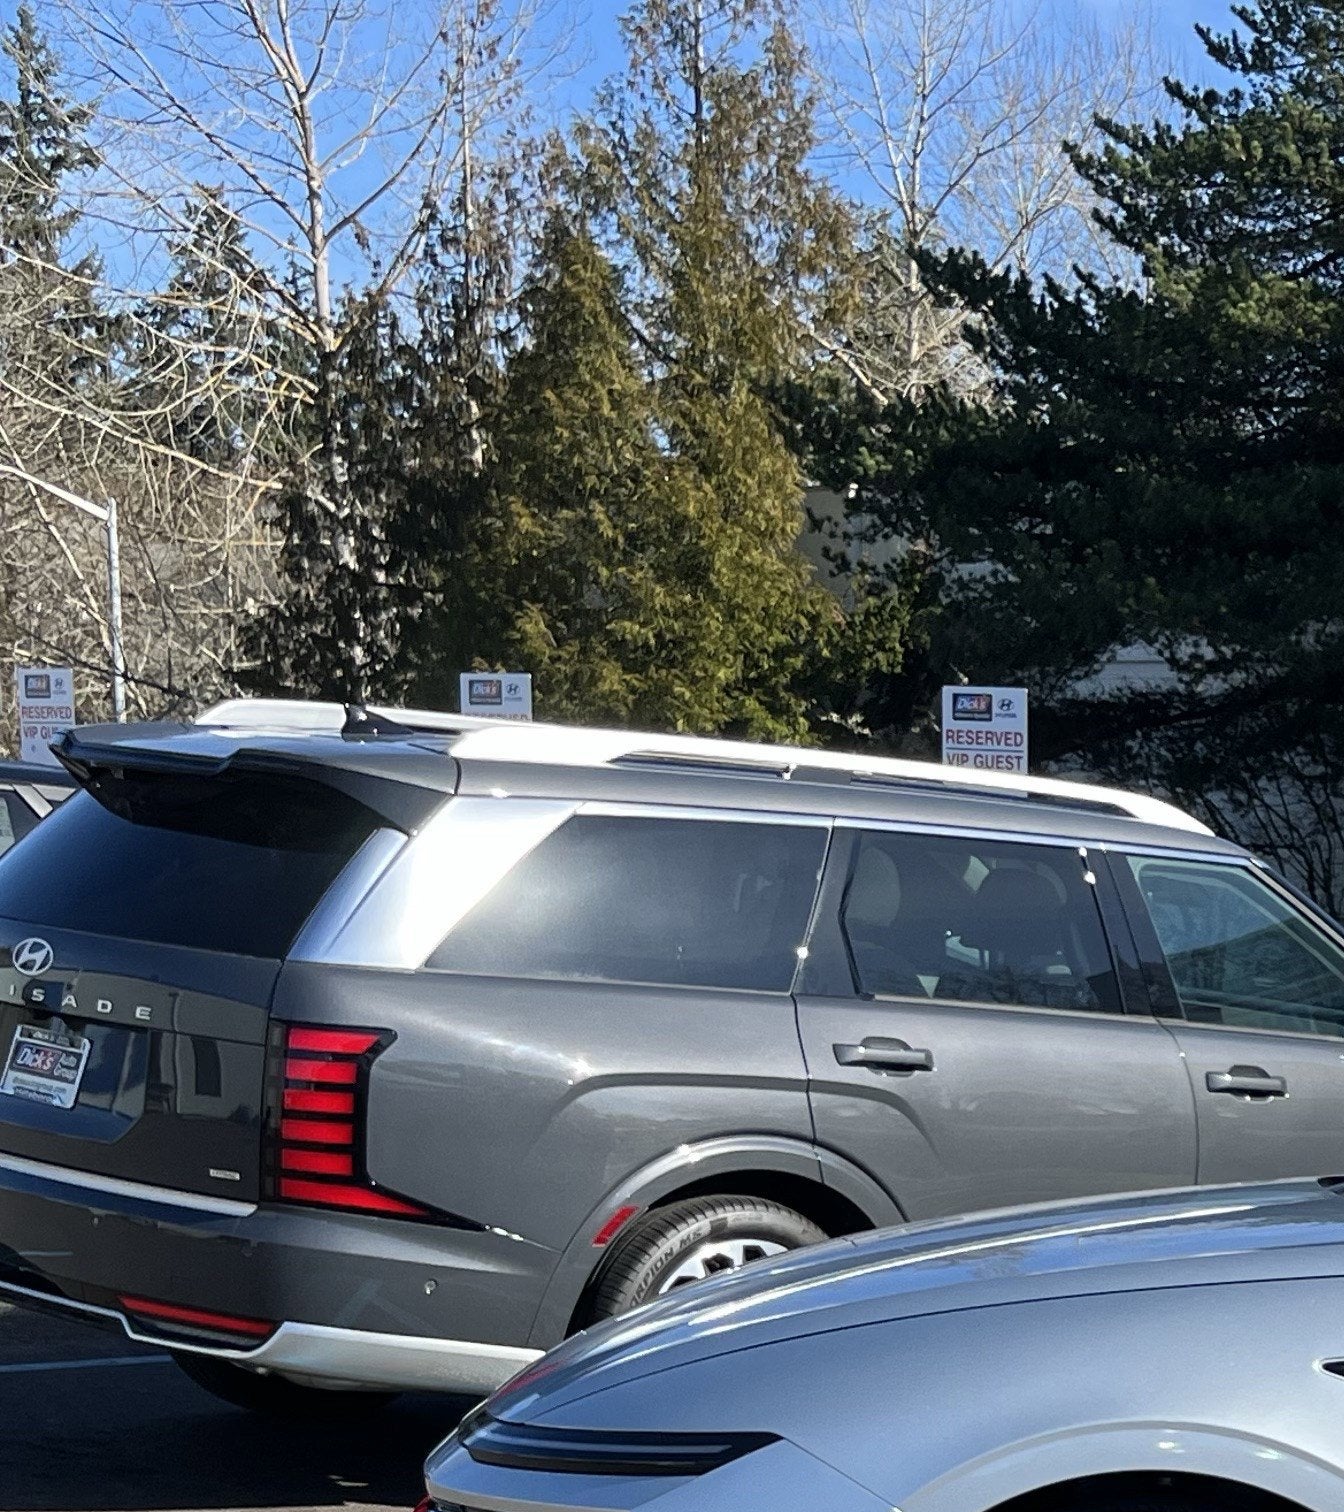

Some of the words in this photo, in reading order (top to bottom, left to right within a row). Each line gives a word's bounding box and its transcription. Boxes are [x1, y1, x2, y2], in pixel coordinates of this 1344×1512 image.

[22, 706, 72, 720] RESERVED
[945, 729, 1024, 747] RESERVED
[946, 753, 969, 766] VIP
[973, 753, 1024, 771] GUEST
